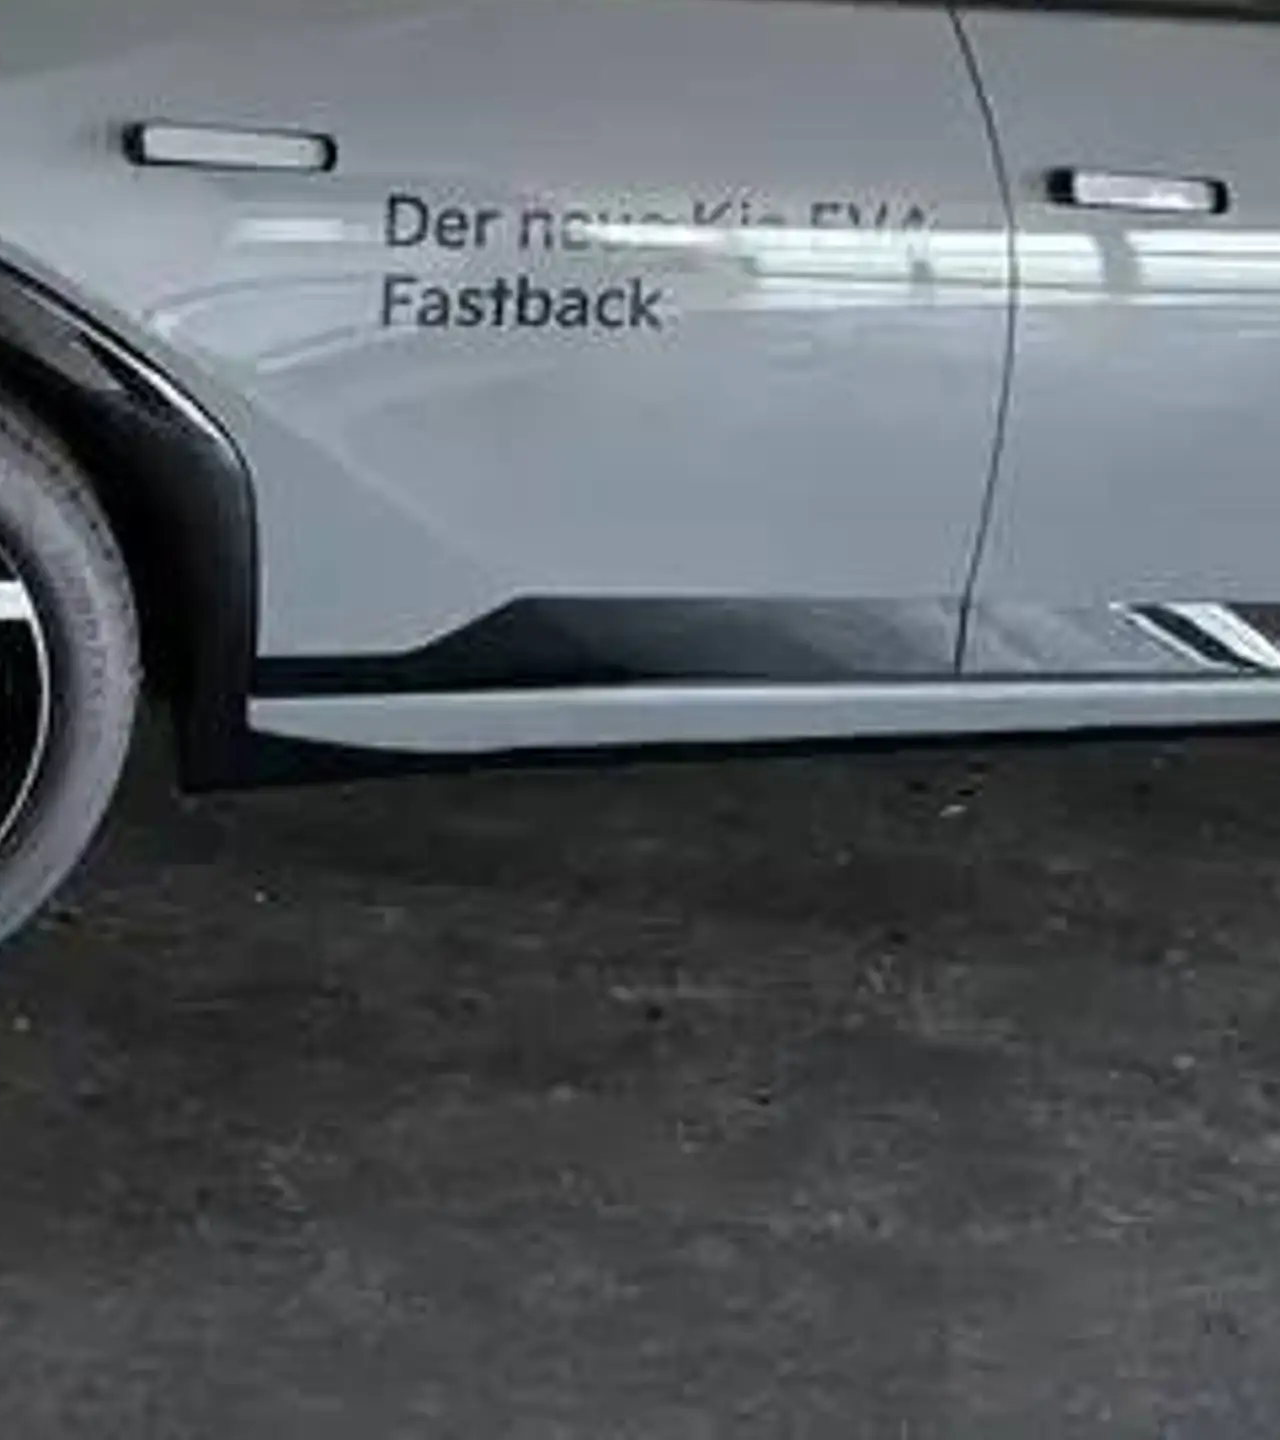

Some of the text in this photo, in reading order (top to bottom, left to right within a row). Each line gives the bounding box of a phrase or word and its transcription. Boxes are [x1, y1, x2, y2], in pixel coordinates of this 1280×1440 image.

[386, 192, 504, 250] Der
[693, 200, 788, 242] Ki
[381, 273, 664, 328] Fastback
